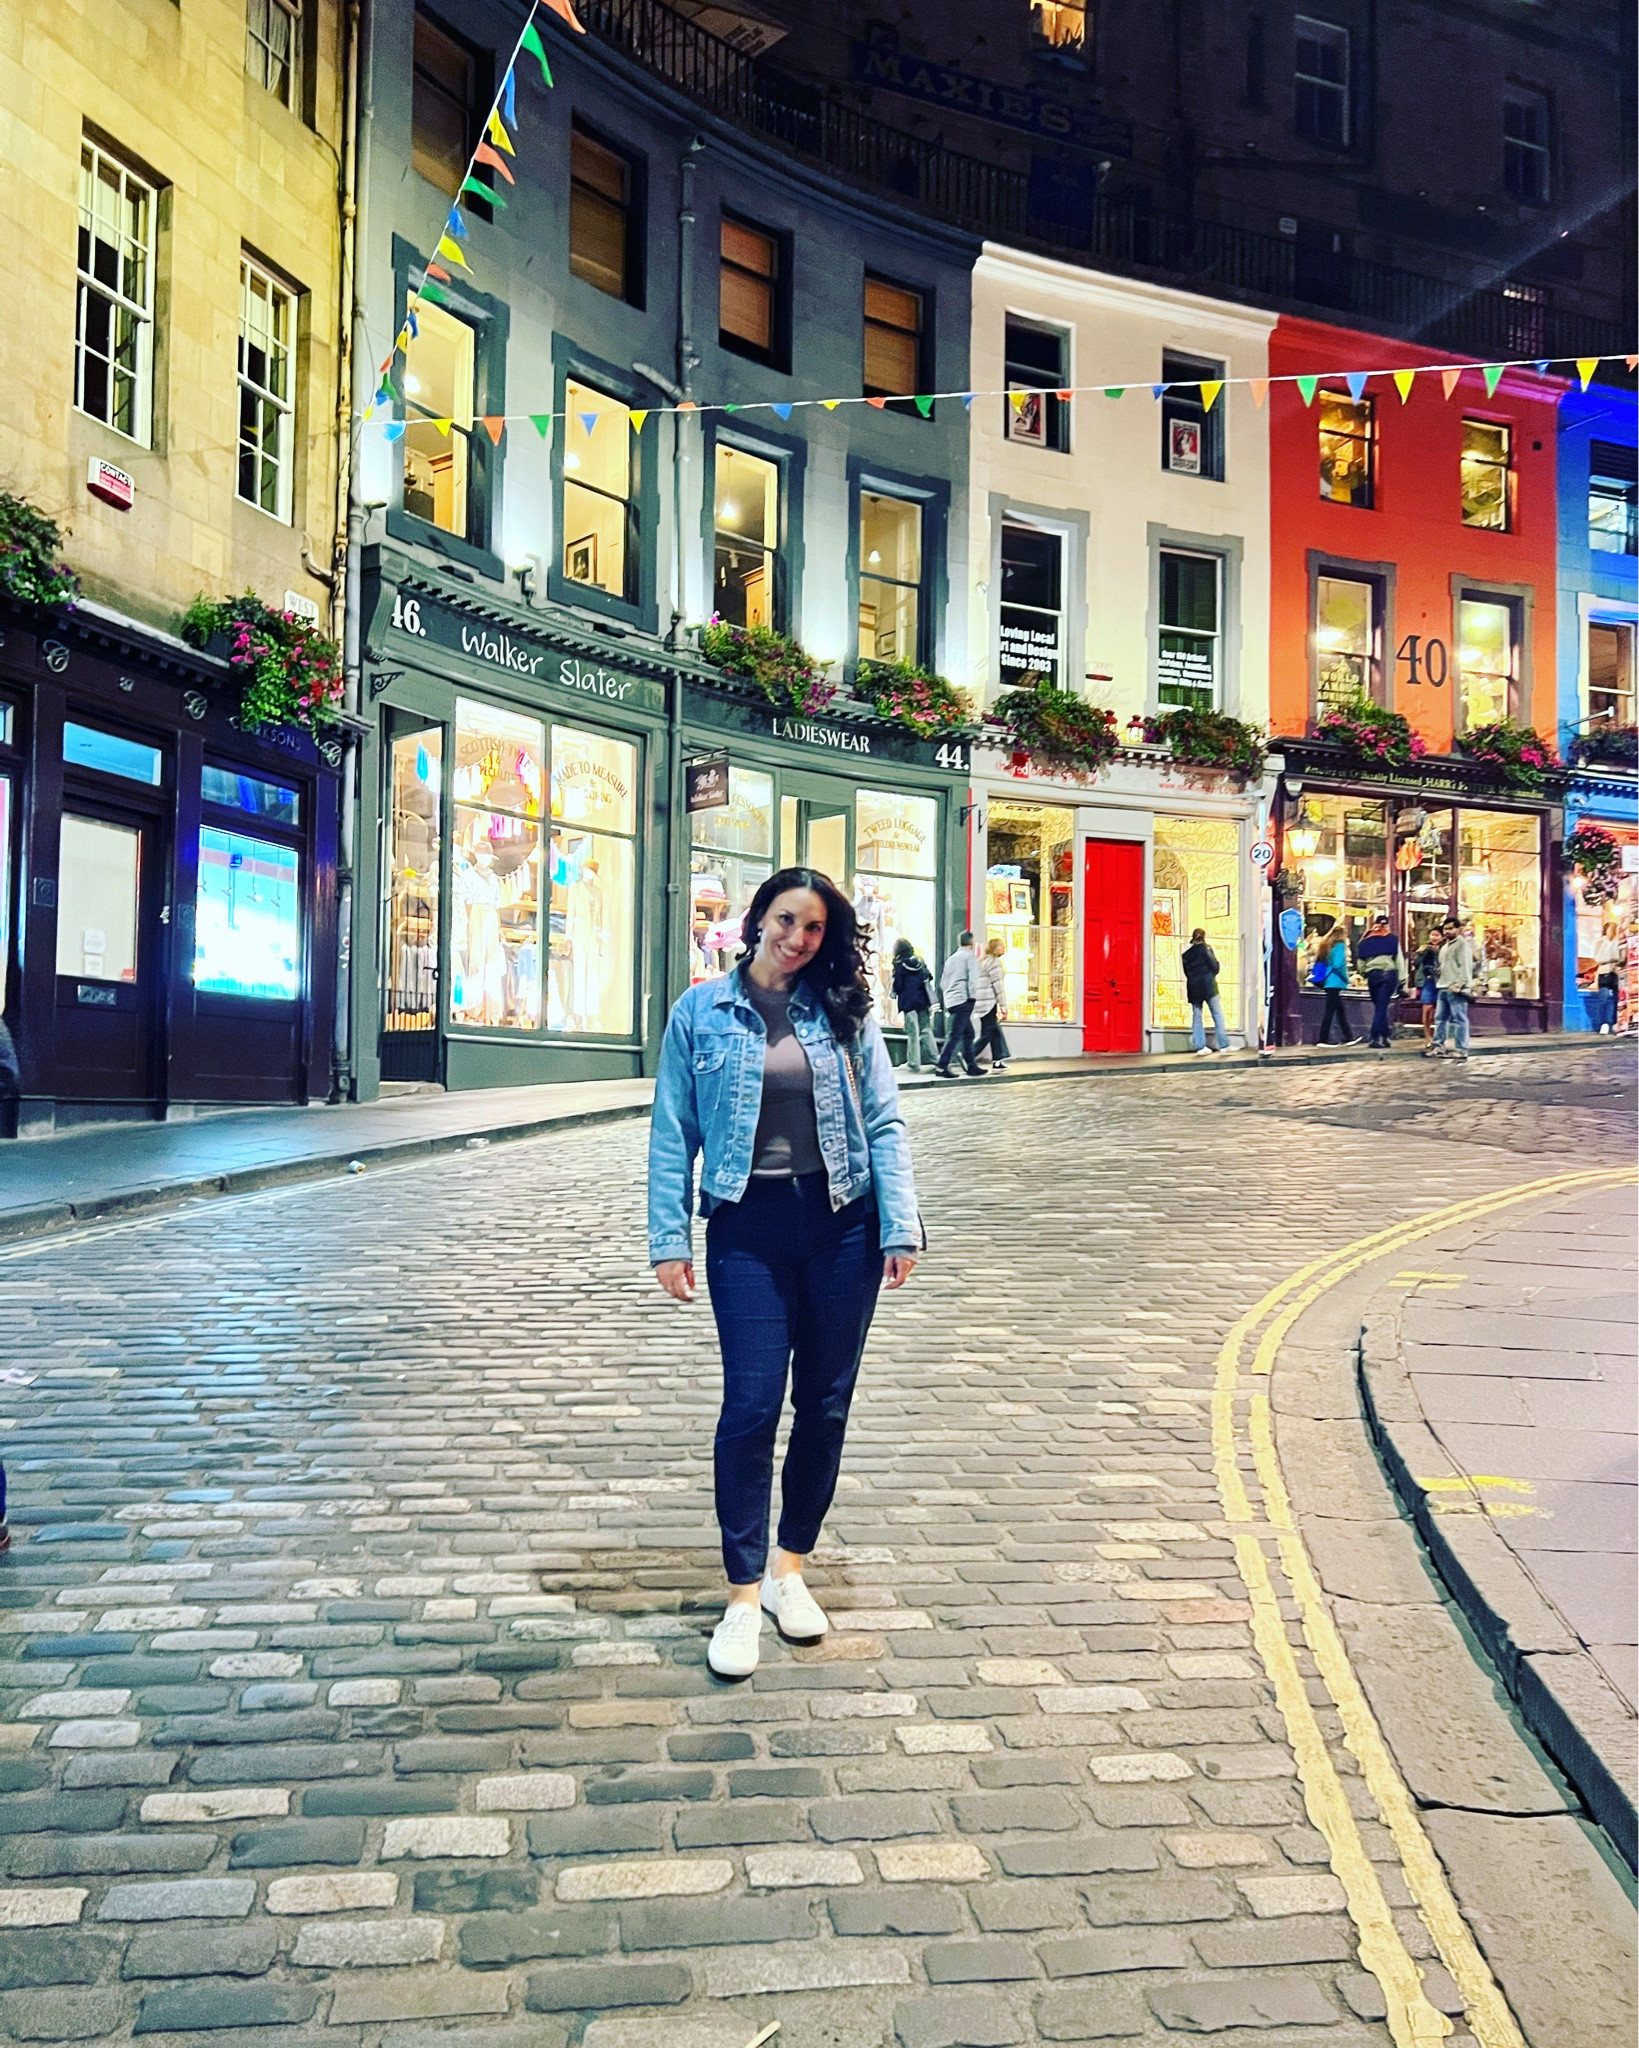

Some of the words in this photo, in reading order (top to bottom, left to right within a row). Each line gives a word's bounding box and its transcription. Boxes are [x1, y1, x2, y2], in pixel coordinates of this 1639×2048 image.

[854, 50, 1073, 134] MAXIES
[289, 594, 315, 618] WEST
[1000, 625, 1029, 642] Loving
[1031, 630, 1055, 645] Local
[1000, 641, 1009, 652] rt
[1010, 643, 1027, 655] and
[460, 626, 544, 675] Walker
[559, 659, 632, 700] Slater
[1001, 653, 1027, 669] Since
[1396, 635, 1447, 687] 40
[772, 717, 871, 753] LADIESWEAR
[553, 762, 579, 785] MADE
[578, 761, 591, 775] TO
[592, 763, 629, 801] MEASURE
[1013, 762, 1030, 777] red
[863, 817, 892, 839] TWEED
[895, 817, 928, 845] LUGGAGE
[1253, 848, 1271, 859] 20
